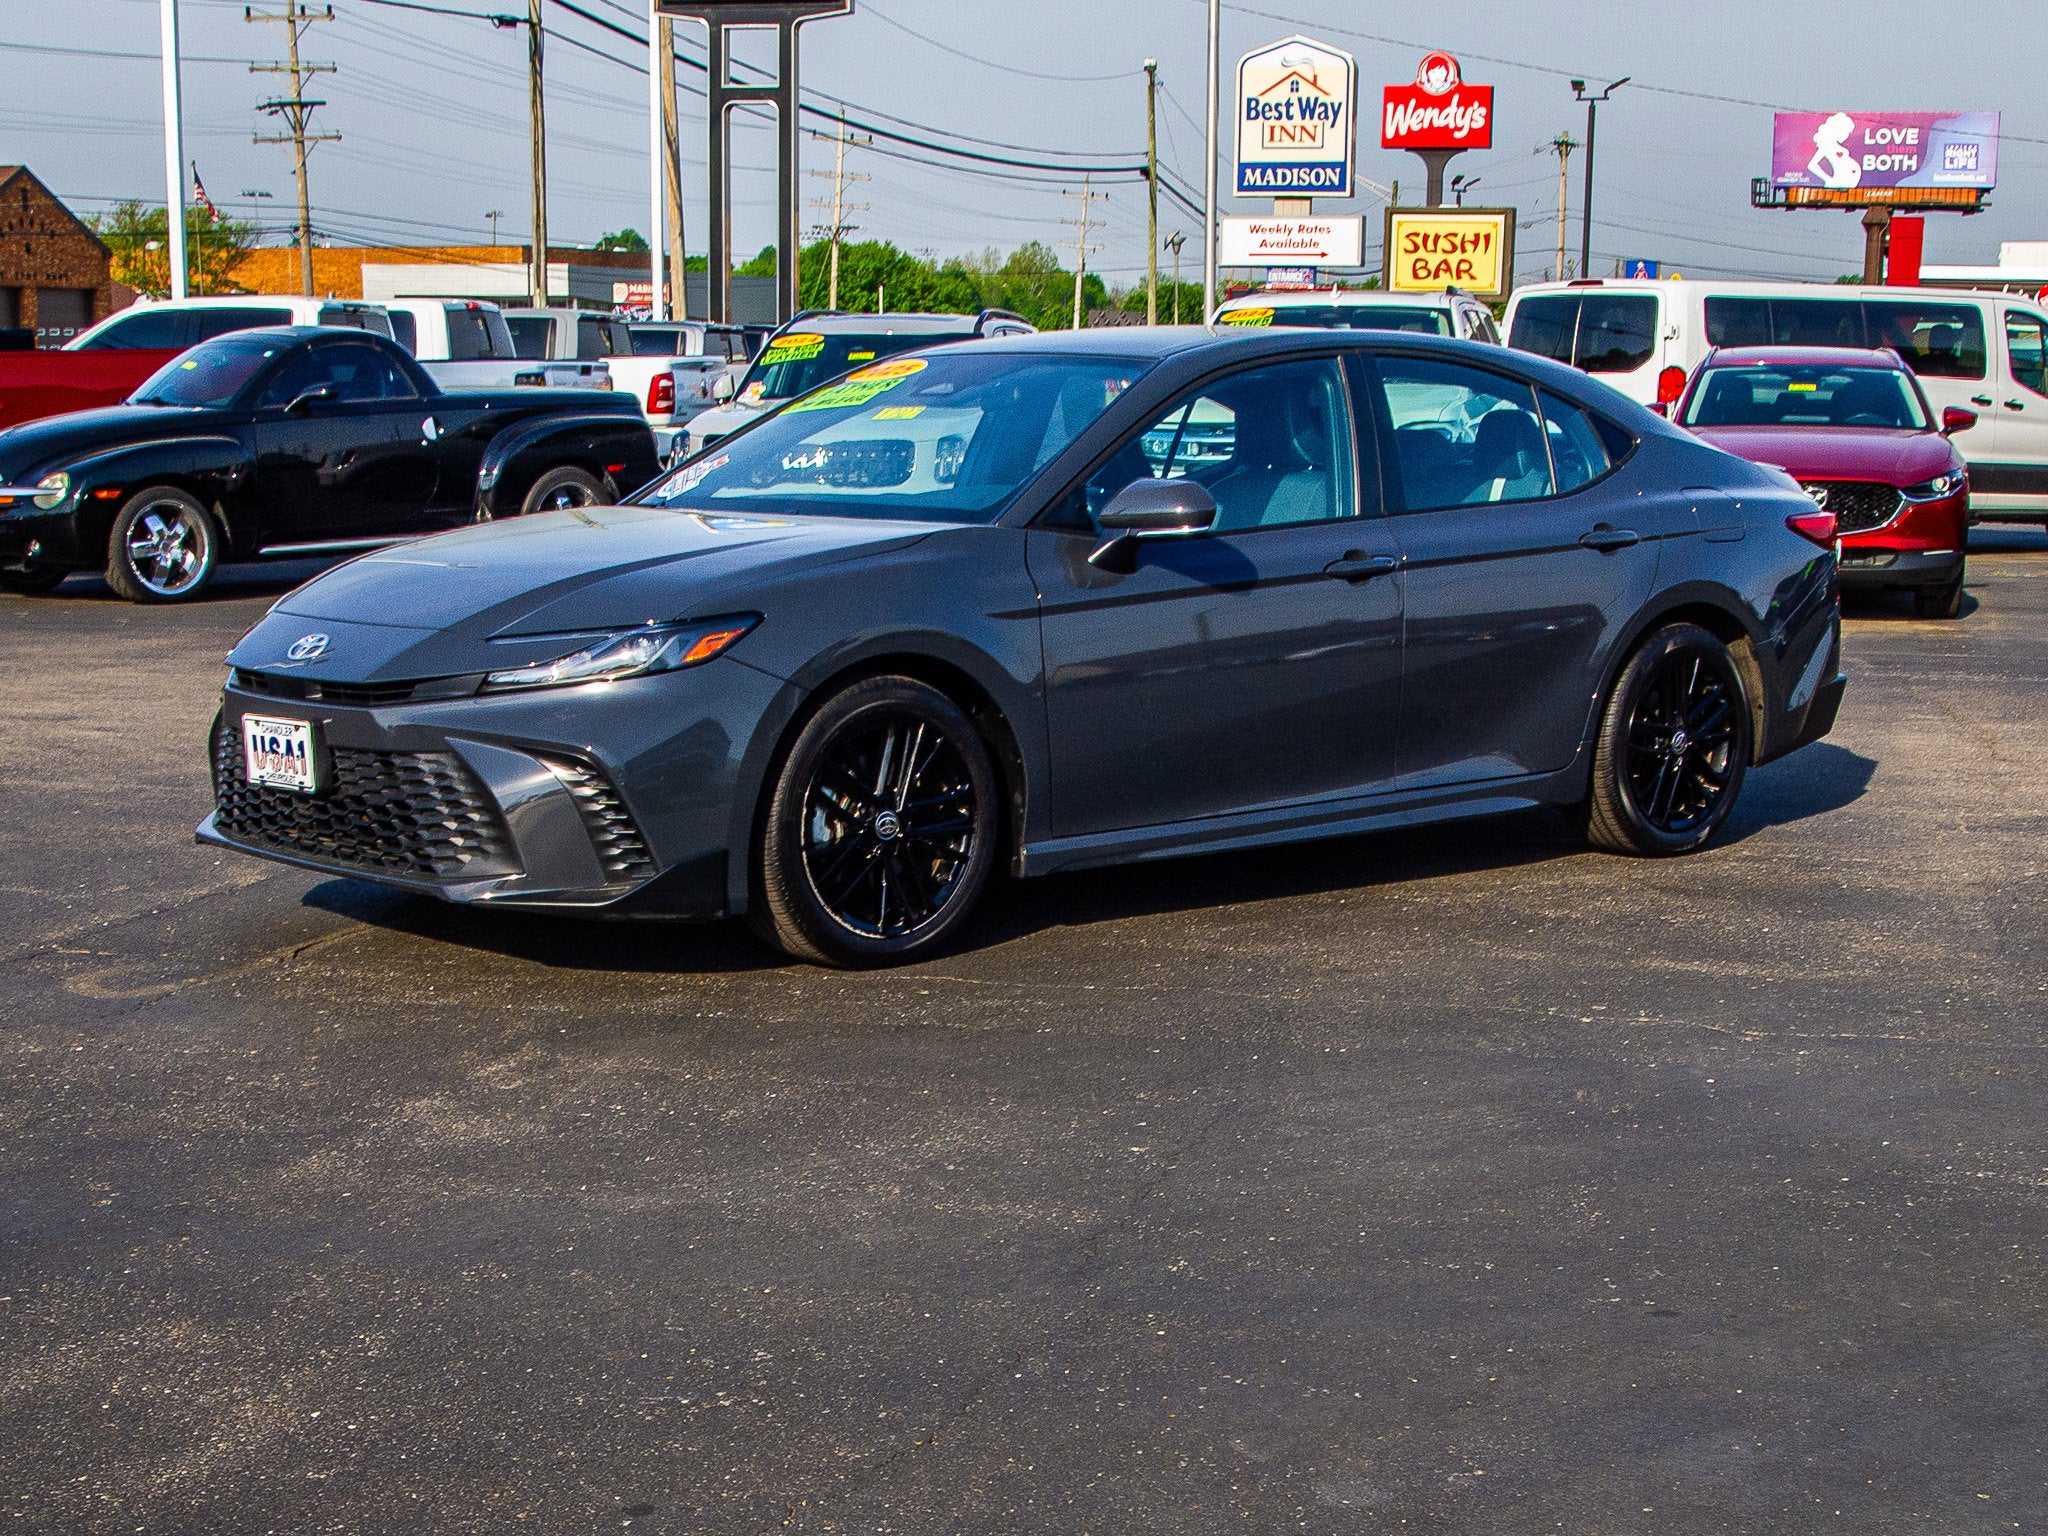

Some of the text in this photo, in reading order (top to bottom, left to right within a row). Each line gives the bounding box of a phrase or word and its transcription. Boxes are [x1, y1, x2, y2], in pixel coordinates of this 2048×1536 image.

[1246, 97, 1343, 128] Best Way
[1385, 94, 1487, 140] Wendy's
[1267, 124, 1318, 142] INN
[1864, 128, 1919, 145] LOVE
[1862, 154, 1918, 172] BOTH
[1945, 157, 1977, 169] LIFE
[1243, 167, 1341, 186] MADISON
[1249, 224, 1331, 236] Weekly Rates
[1259, 238, 1320, 249] Available
[1403, 232, 1491, 255] SUSHI
[1412, 258, 1477, 281] BAR
[252, 735, 307, 776] USA1
